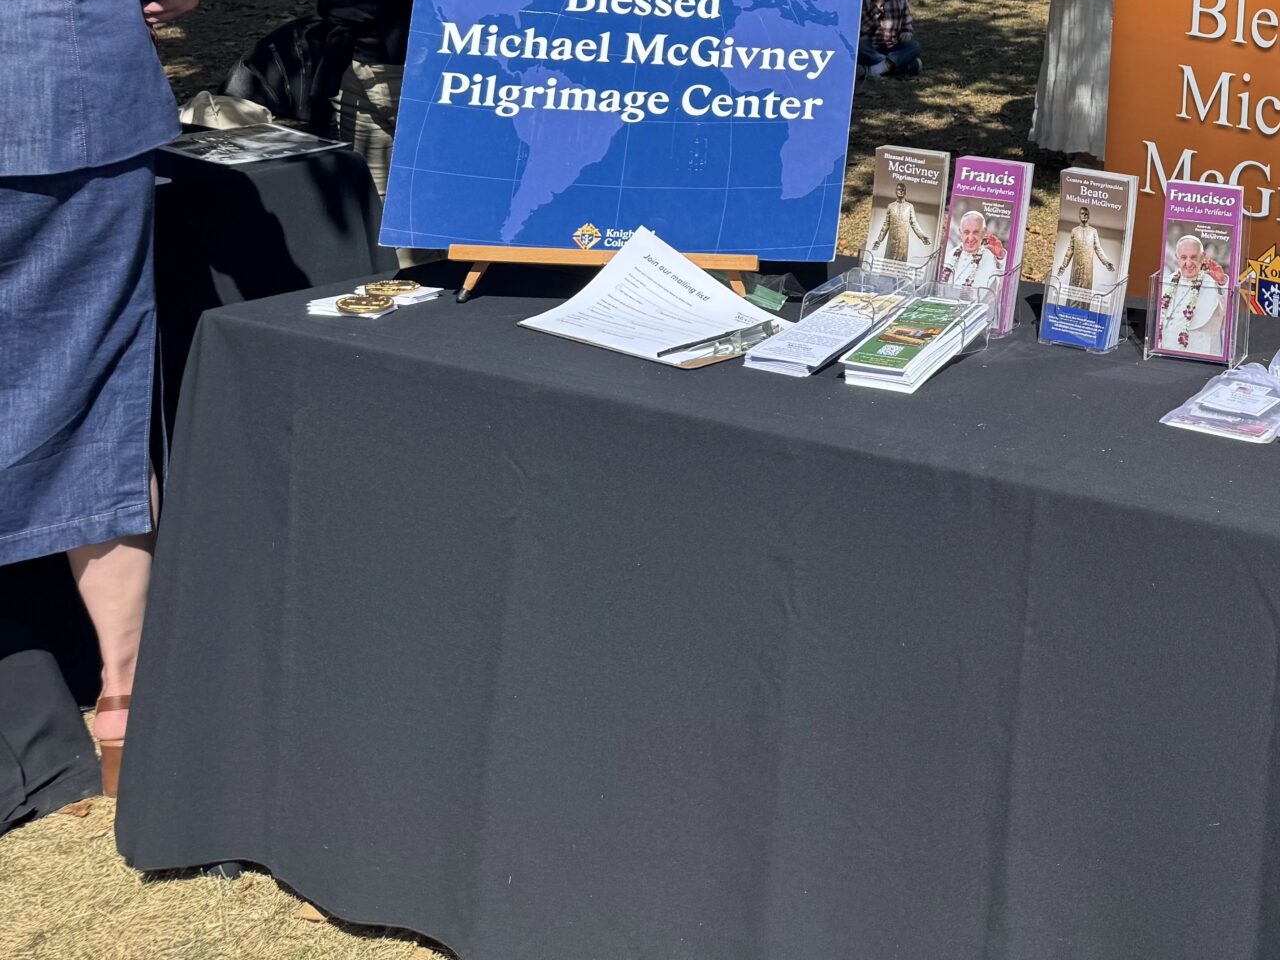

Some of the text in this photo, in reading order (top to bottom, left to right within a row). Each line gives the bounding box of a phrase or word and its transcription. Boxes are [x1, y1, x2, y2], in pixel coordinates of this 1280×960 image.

[437, 22, 835, 81] Michael McGivney
[438, 72, 824, 123] Pilgrimage Center
[904, 156, 925, 164] Michael
[888, 161, 939, 180] McGivney
[892, 173, 920, 183] Pilgrimage
[961, 167, 1015, 185] Francis
[986, 187, 1014, 195] Peripheries
[1081, 186, 1108, 200] Beato
[1170, 189, 1235, 206] Francisco
[1066, 194, 1122, 210] Michael McGivney
[1170, 205, 1184, 213] Papa
[1204, 208, 1232, 217] Periferias
[606, 228, 635, 240] Knigh
[644, 254, 710, 301] Join our mailing list!
[1260, 265, 1269, 278] K
